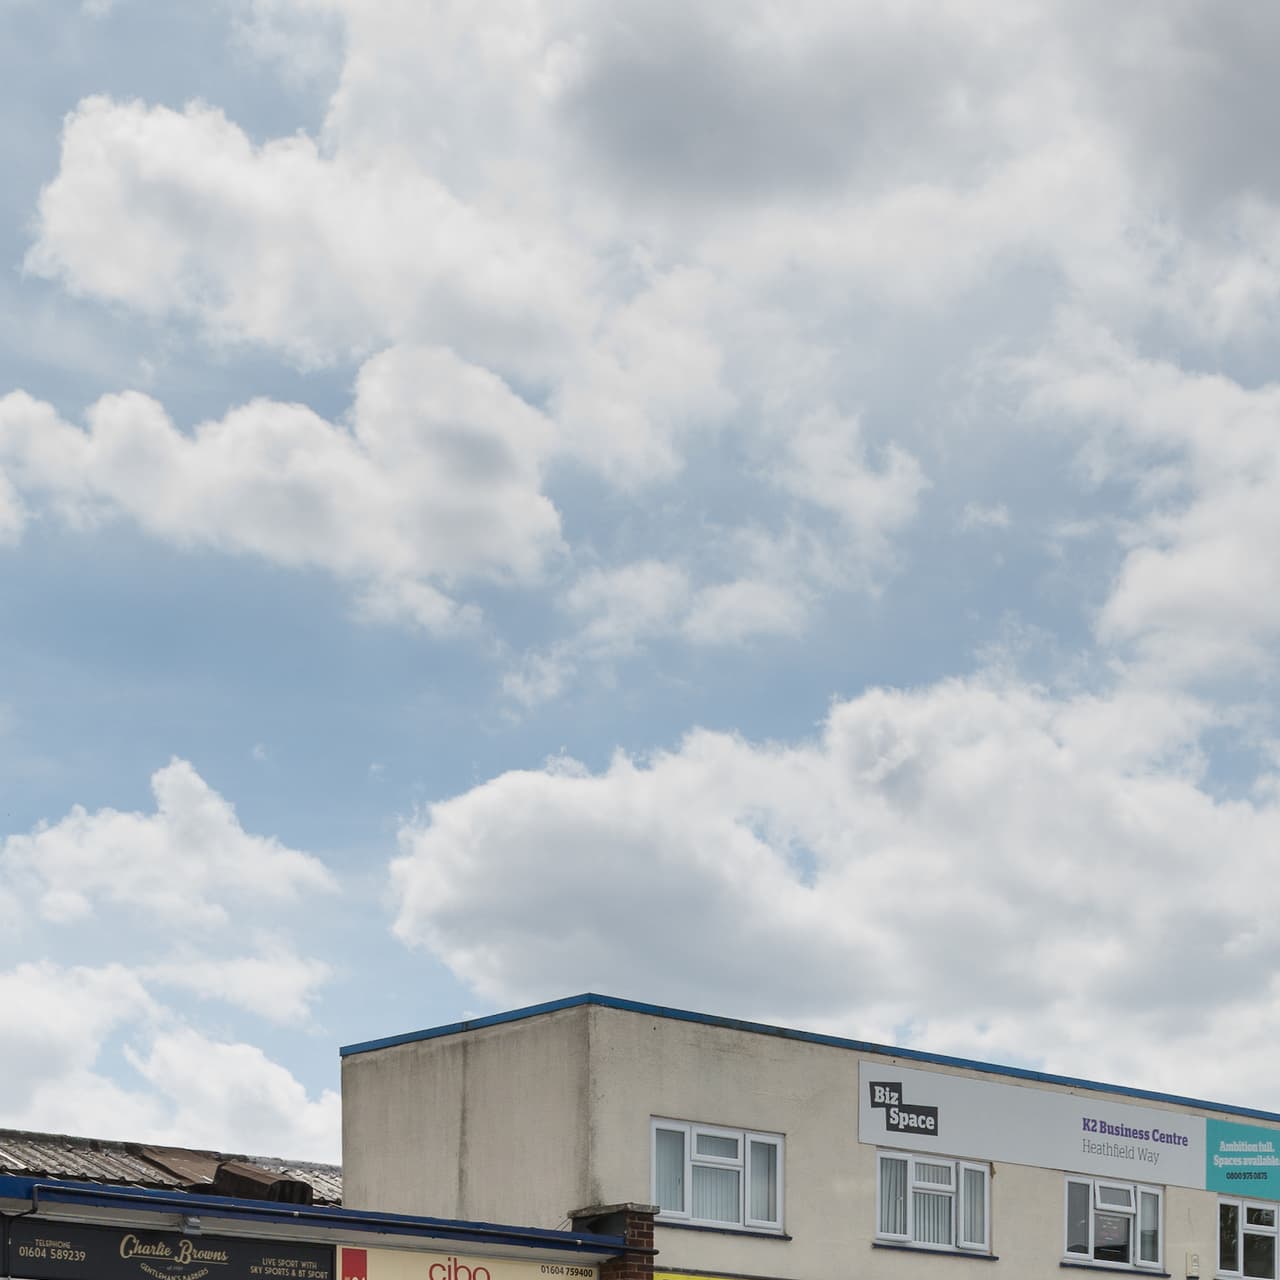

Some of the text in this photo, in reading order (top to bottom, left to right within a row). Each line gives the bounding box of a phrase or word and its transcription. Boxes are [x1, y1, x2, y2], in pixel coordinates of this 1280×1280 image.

[874, 1086, 899, 1105] Biz
[889, 1108, 935, 1132] Space
[1082, 1118, 1188, 1146] K2 Business Centre
[1082, 1140, 1159, 1166] Heathfield Way
[1220, 1141, 1257, 1152] Ambition
[1213, 1155, 1280, 1167] Spaces available.
[35, 1238, 71, 1249] TELEPHONE
[120, 1233, 228, 1265] Charlie Browns
[19, 1246, 86, 1262] 01604 589239
[263, 1257, 317, 1270] LIVE SPORT WITH
[250, 1266, 328, 1279] SKY SPORTS & BT SPORT
[540, 1265, 592, 1278] 01604 759400
